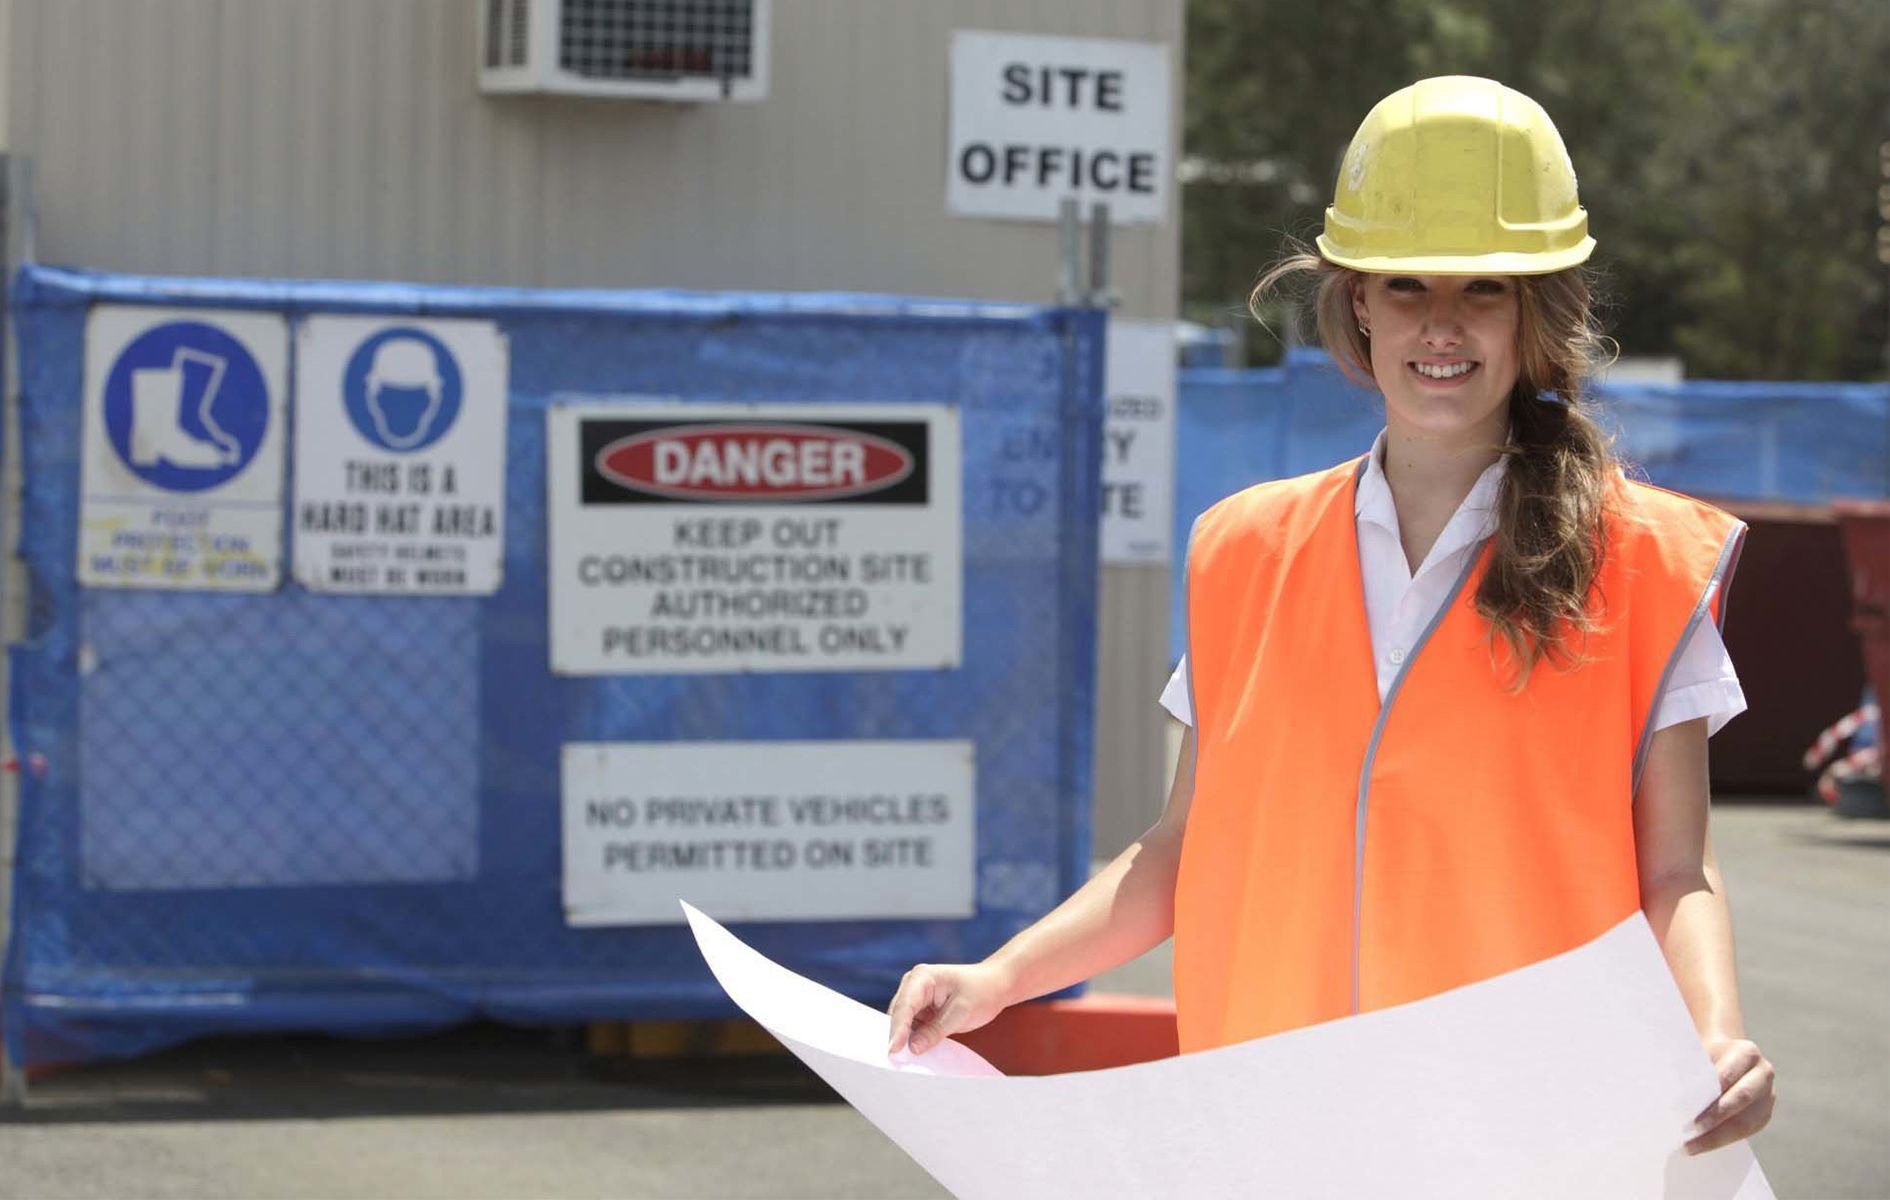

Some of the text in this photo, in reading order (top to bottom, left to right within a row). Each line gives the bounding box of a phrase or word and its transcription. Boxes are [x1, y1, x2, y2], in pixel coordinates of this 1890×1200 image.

[1003, 64, 1124, 111] SITE
[960, 144, 1156, 193] OFFICE
[344, 460, 458, 496] THIS IS A
[654, 440, 866, 486] DANGER
[302, 503, 496, 537] HARD HAT AREA
[674, 519, 842, 548] KEEP OUT
[90, 554, 151, 574] MUST
[330, 543, 388, 560] SAFETY
[330, 567, 466, 585] MUST BE WORN
[579, 554, 932, 586] CONSTRUCTION SITE
[650, 589, 868, 620] AUTHORIZED
[603, 625, 909, 657] PERSONNEL ONLY
[586, 795, 951, 828] NO PRIVATE VEHICLES
[604, 838, 934, 872] PERMITTED ON SITE
